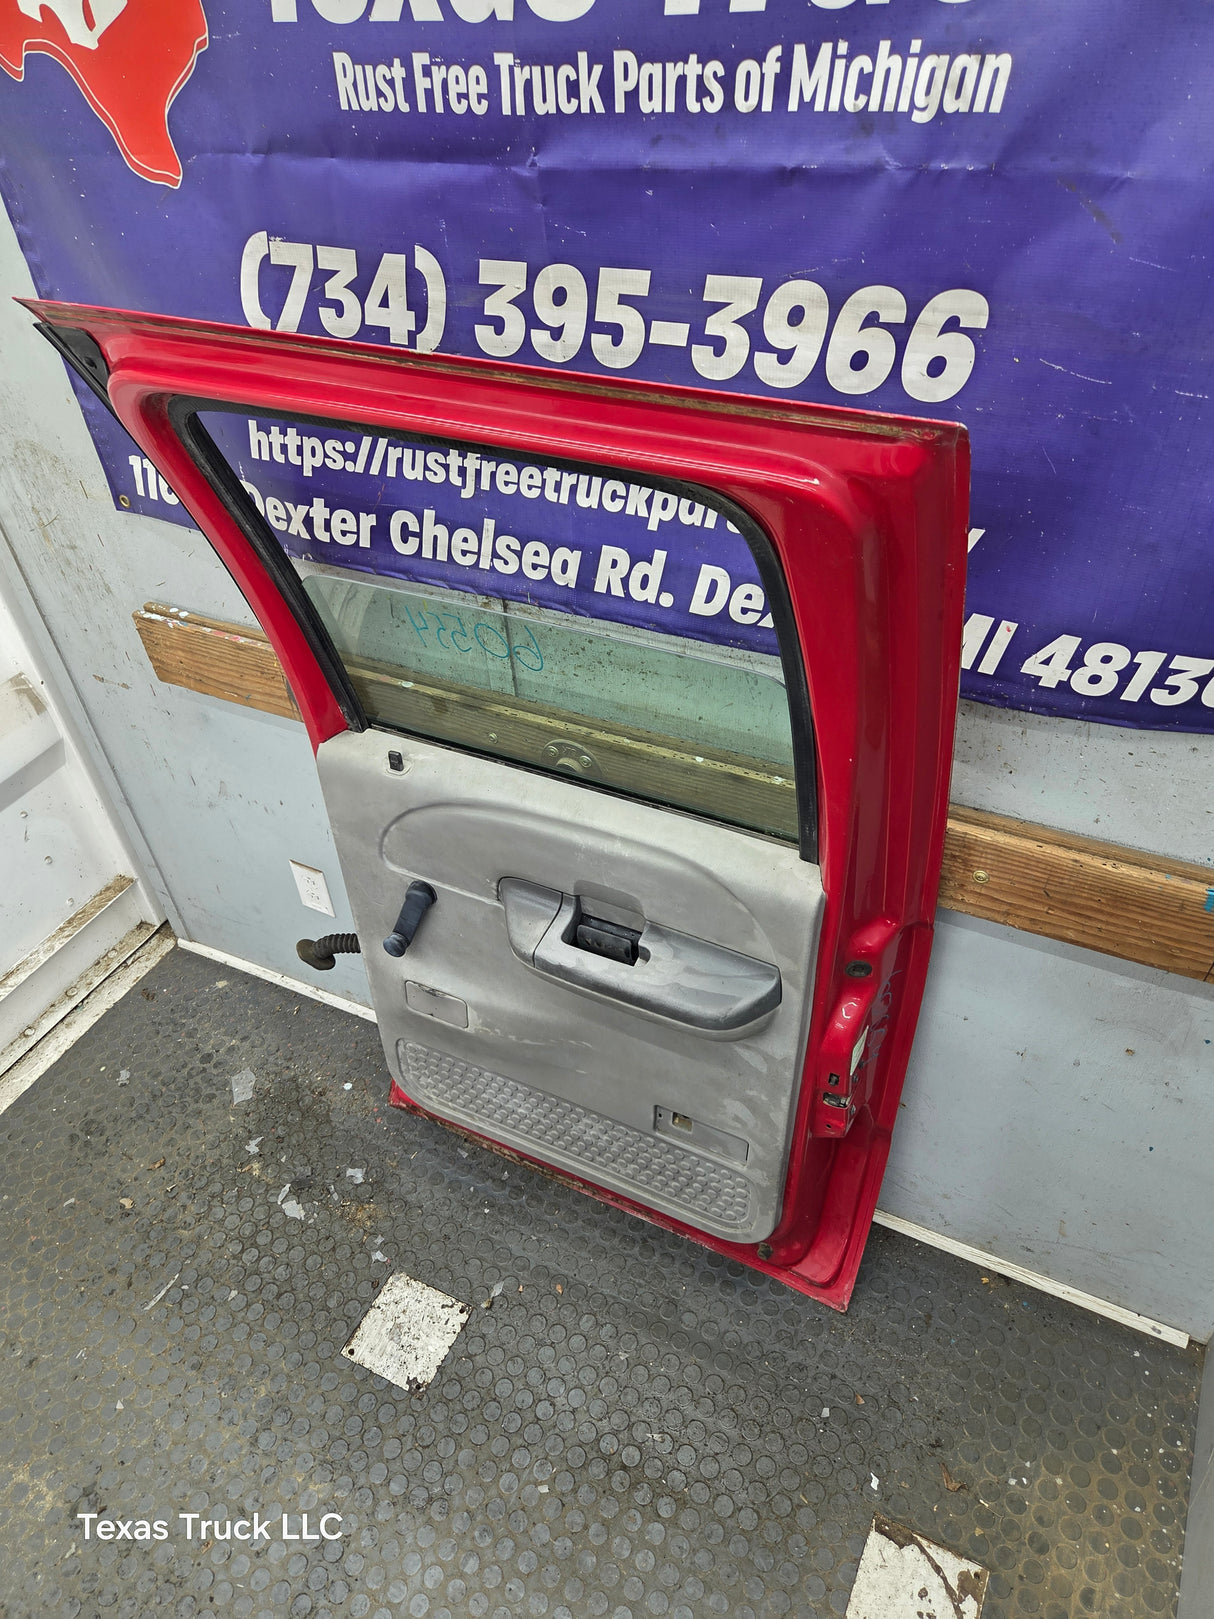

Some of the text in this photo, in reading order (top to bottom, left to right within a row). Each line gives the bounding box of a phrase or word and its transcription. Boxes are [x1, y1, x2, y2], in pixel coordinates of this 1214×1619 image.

[332, 38, 1012, 124] Rust Free Truck Parts of Michigan
[240, 230, 990, 402] (734) 395-3966
[389, 508, 582, 589] Chelsea
[594, 544, 674, 608] Rd.
[1020, 633, 1214, 708] 4813
